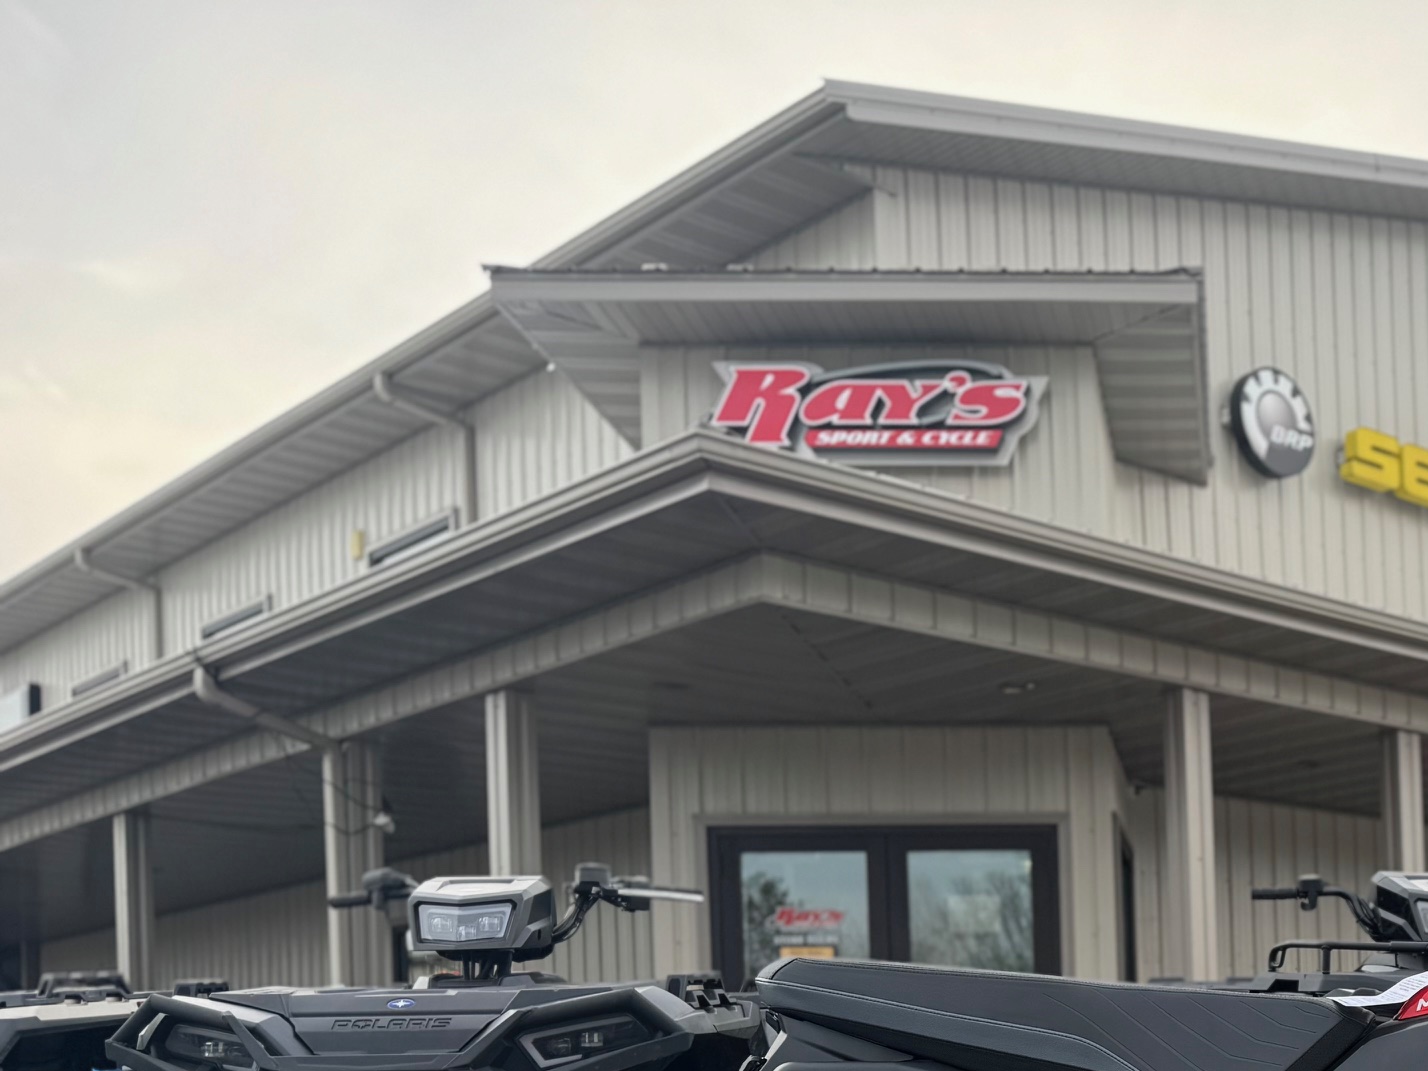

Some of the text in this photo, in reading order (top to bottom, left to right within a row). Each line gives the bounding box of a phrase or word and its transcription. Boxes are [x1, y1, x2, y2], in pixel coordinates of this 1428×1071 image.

[711, 367, 1028, 444] Ray's
[815, 430, 993, 446] SPORT & CYCLE
[331, 1018, 452, 1030] POLARIS
